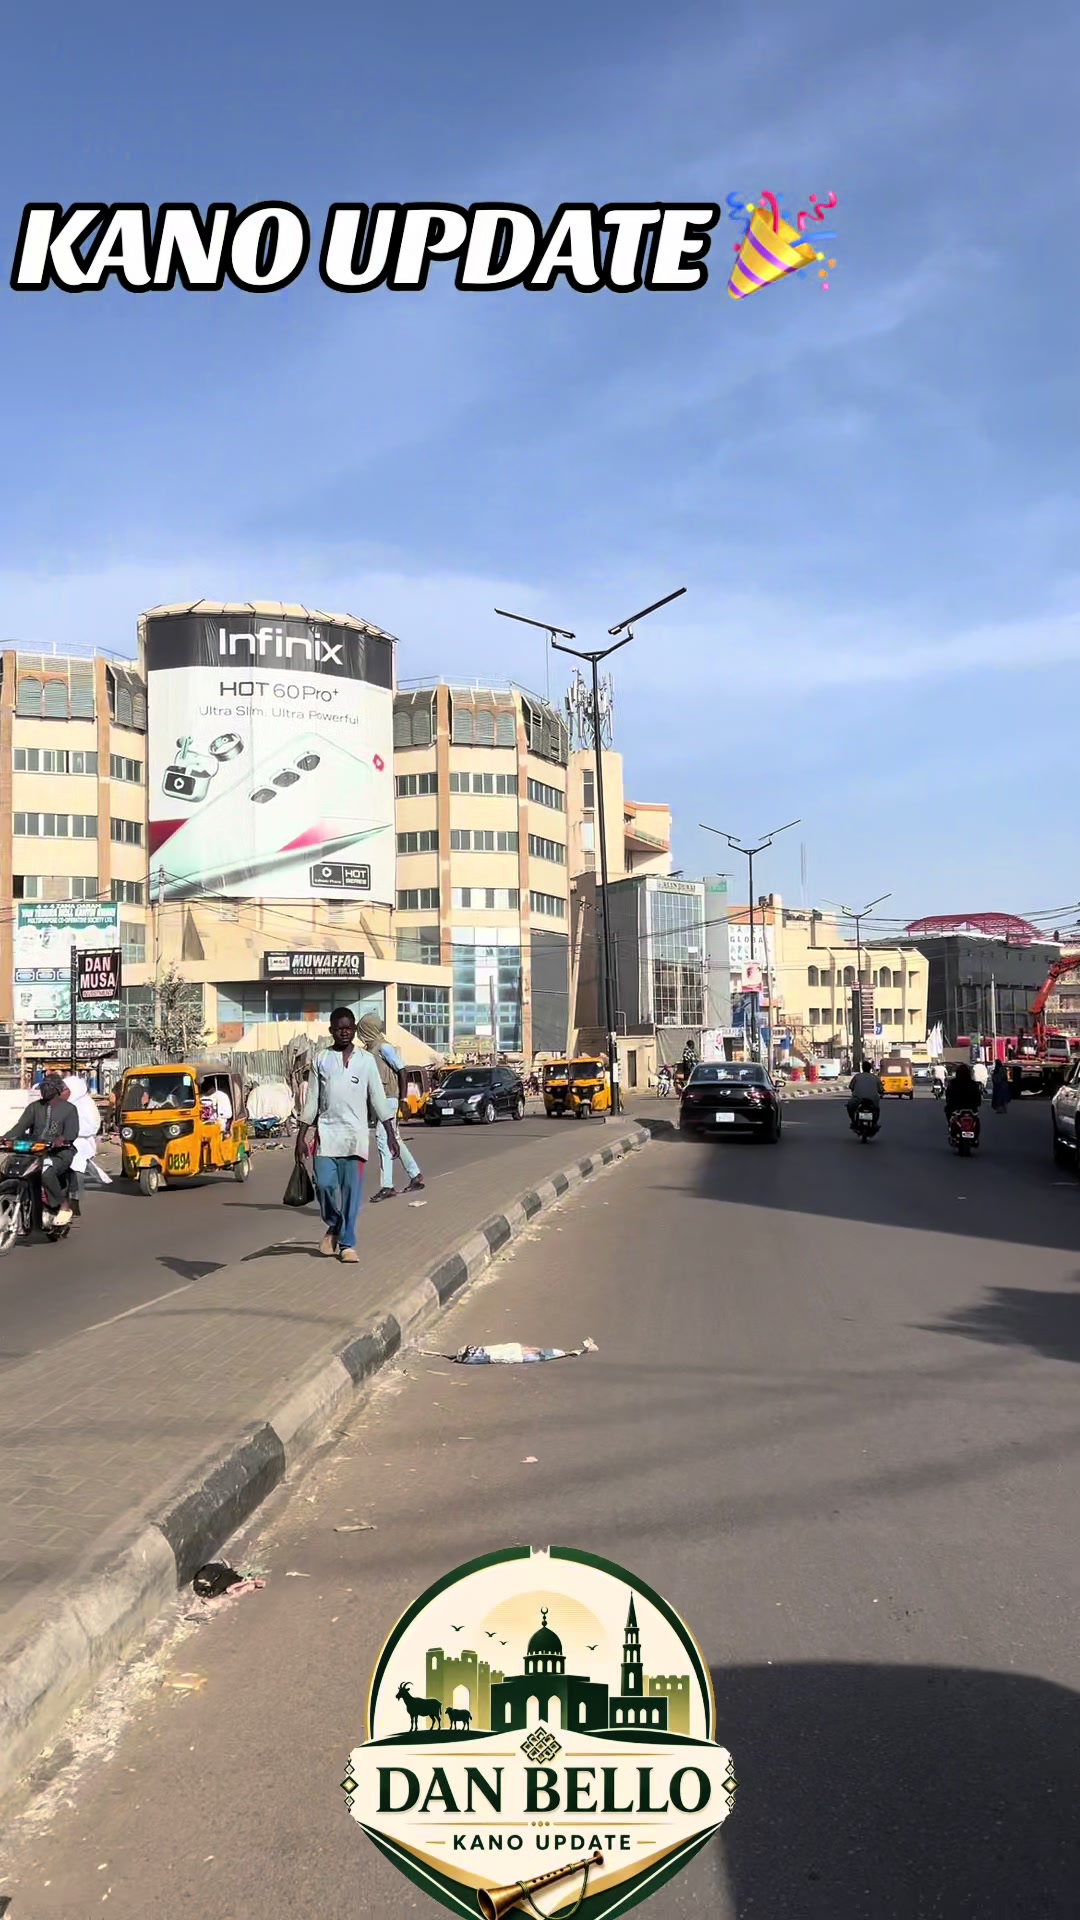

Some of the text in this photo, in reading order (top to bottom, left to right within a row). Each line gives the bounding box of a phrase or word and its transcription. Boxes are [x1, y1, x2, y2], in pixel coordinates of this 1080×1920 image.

[219, 627, 343, 665] Infinix
[220, 682, 269, 696] HOT
[273, 684, 299, 699] 60
[199, 705, 232, 716] Ultra
[271, 707, 304, 720] Ultra
[308, 711, 359, 725] Powerful
[345, 869, 367, 879] HOT
[85, 957, 111, 972] DAN
[291, 954, 360, 969] MUWAFFAQ
[80, 973, 116, 989] MUSA
